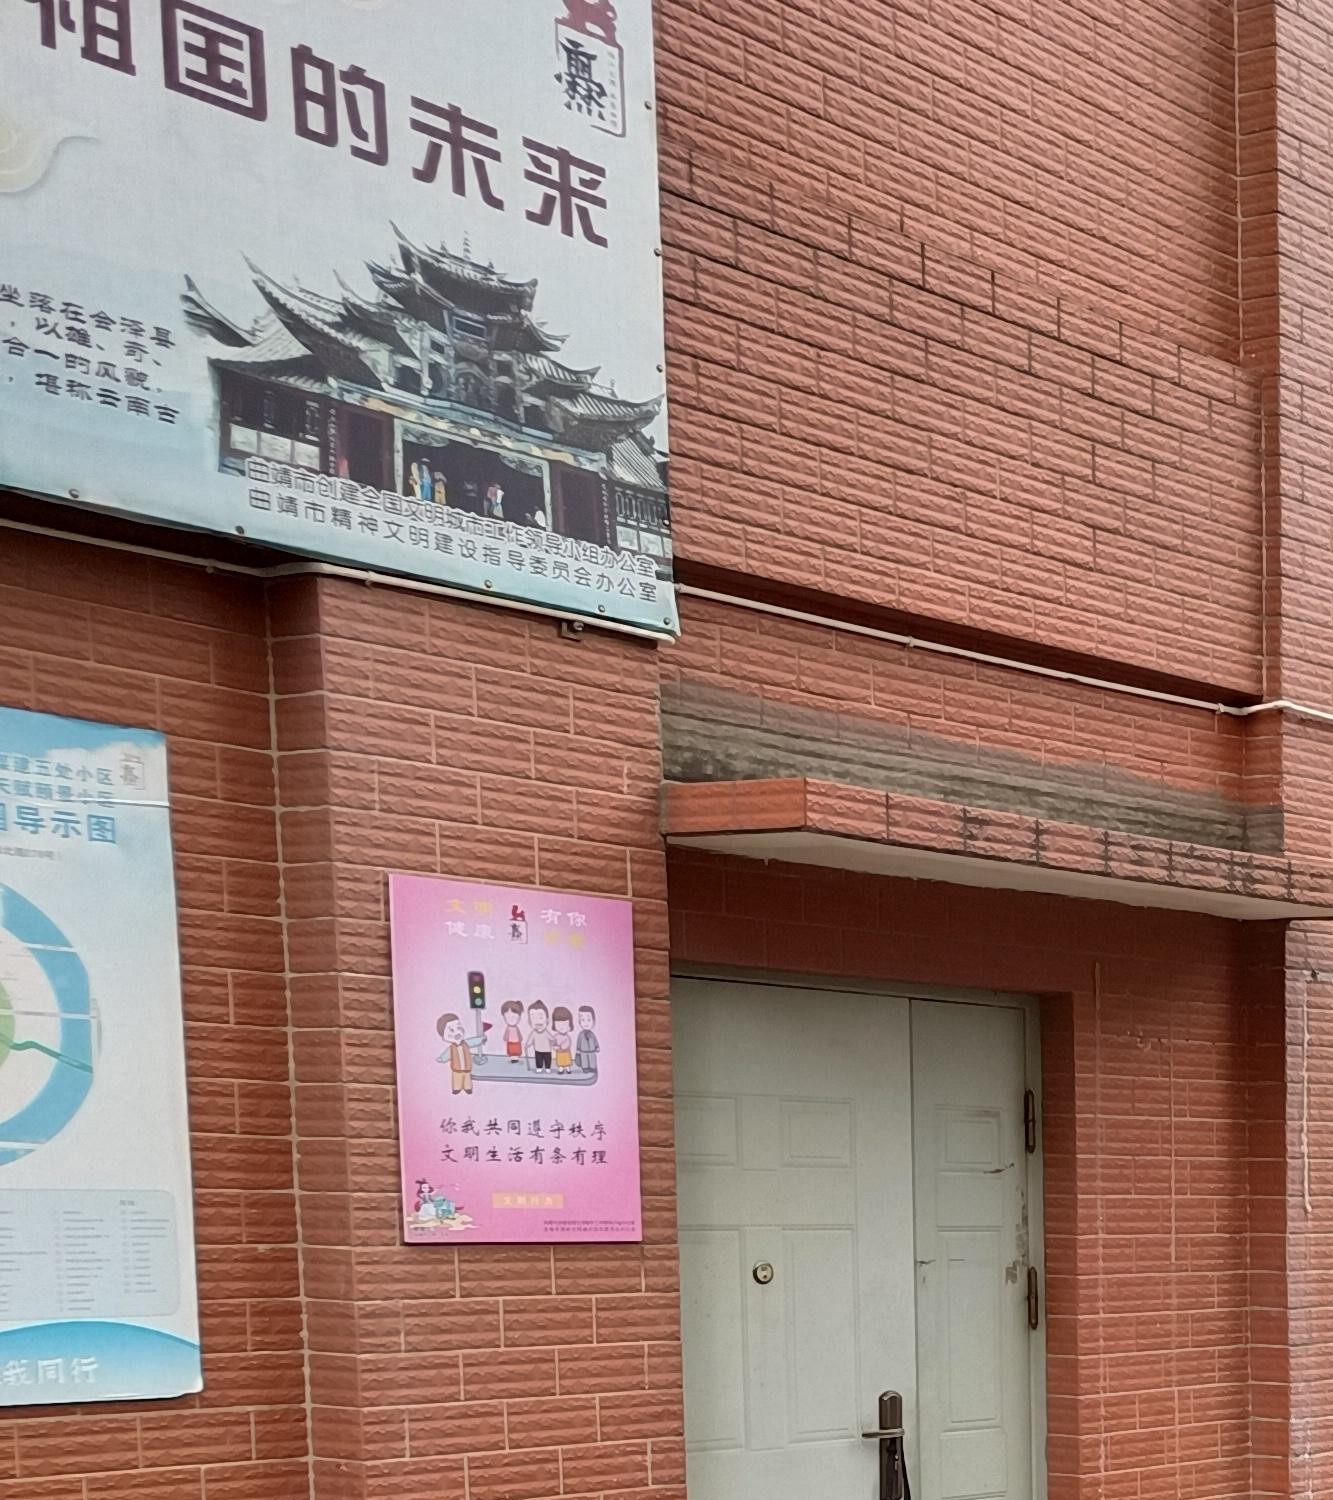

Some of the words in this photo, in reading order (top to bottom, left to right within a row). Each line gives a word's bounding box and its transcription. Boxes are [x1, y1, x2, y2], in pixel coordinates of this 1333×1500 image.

[249, 488, 657, 603] 曲靖市精神文明建设指导委员会办公室
[440, 1118, 608, 1141] 你我共同遵守秩序
[441, 1145, 609, 1165] 文明生活有条有理
